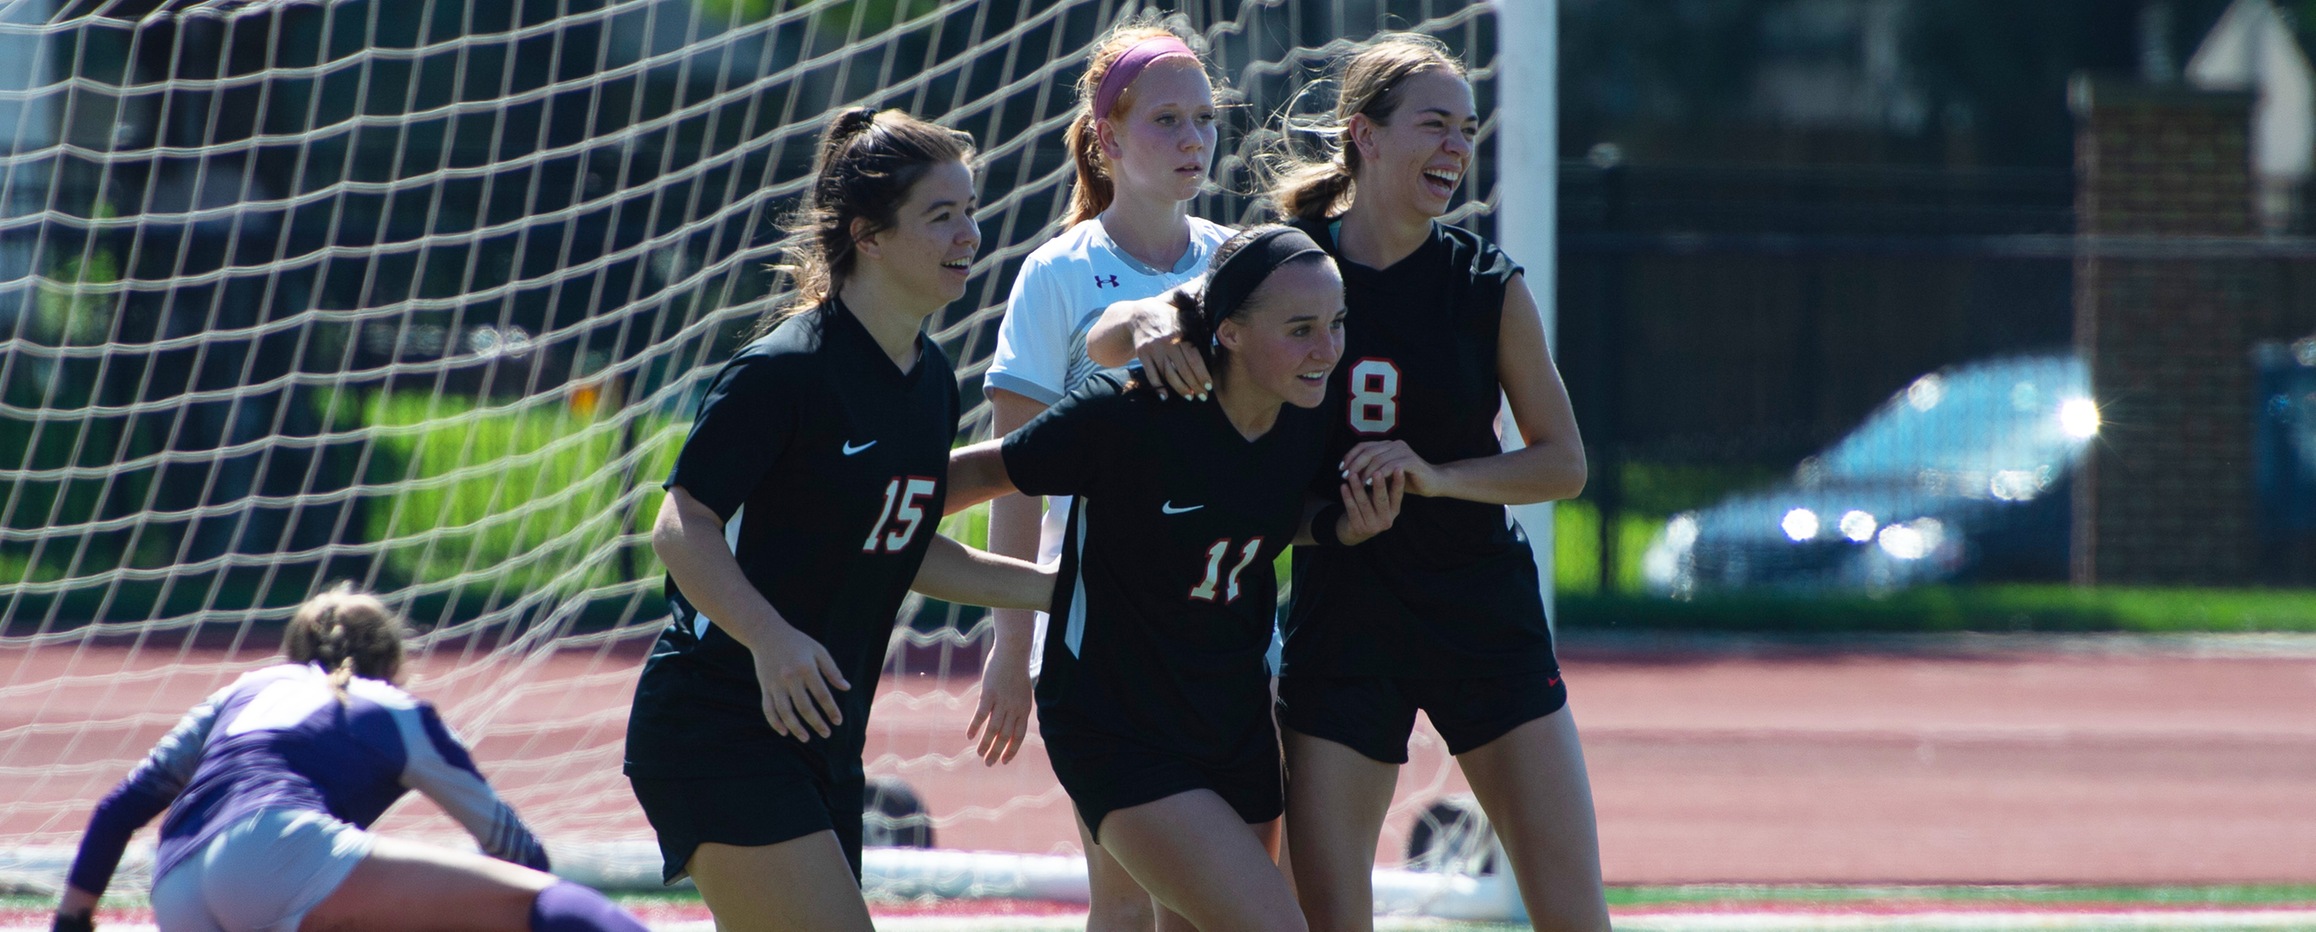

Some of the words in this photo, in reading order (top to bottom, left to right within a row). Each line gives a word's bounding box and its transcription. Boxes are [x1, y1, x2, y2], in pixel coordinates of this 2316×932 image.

[1347, 357, 1402, 436] 8
[863, 475, 937, 553] 15
[1188, 536, 1264, 605] 11
